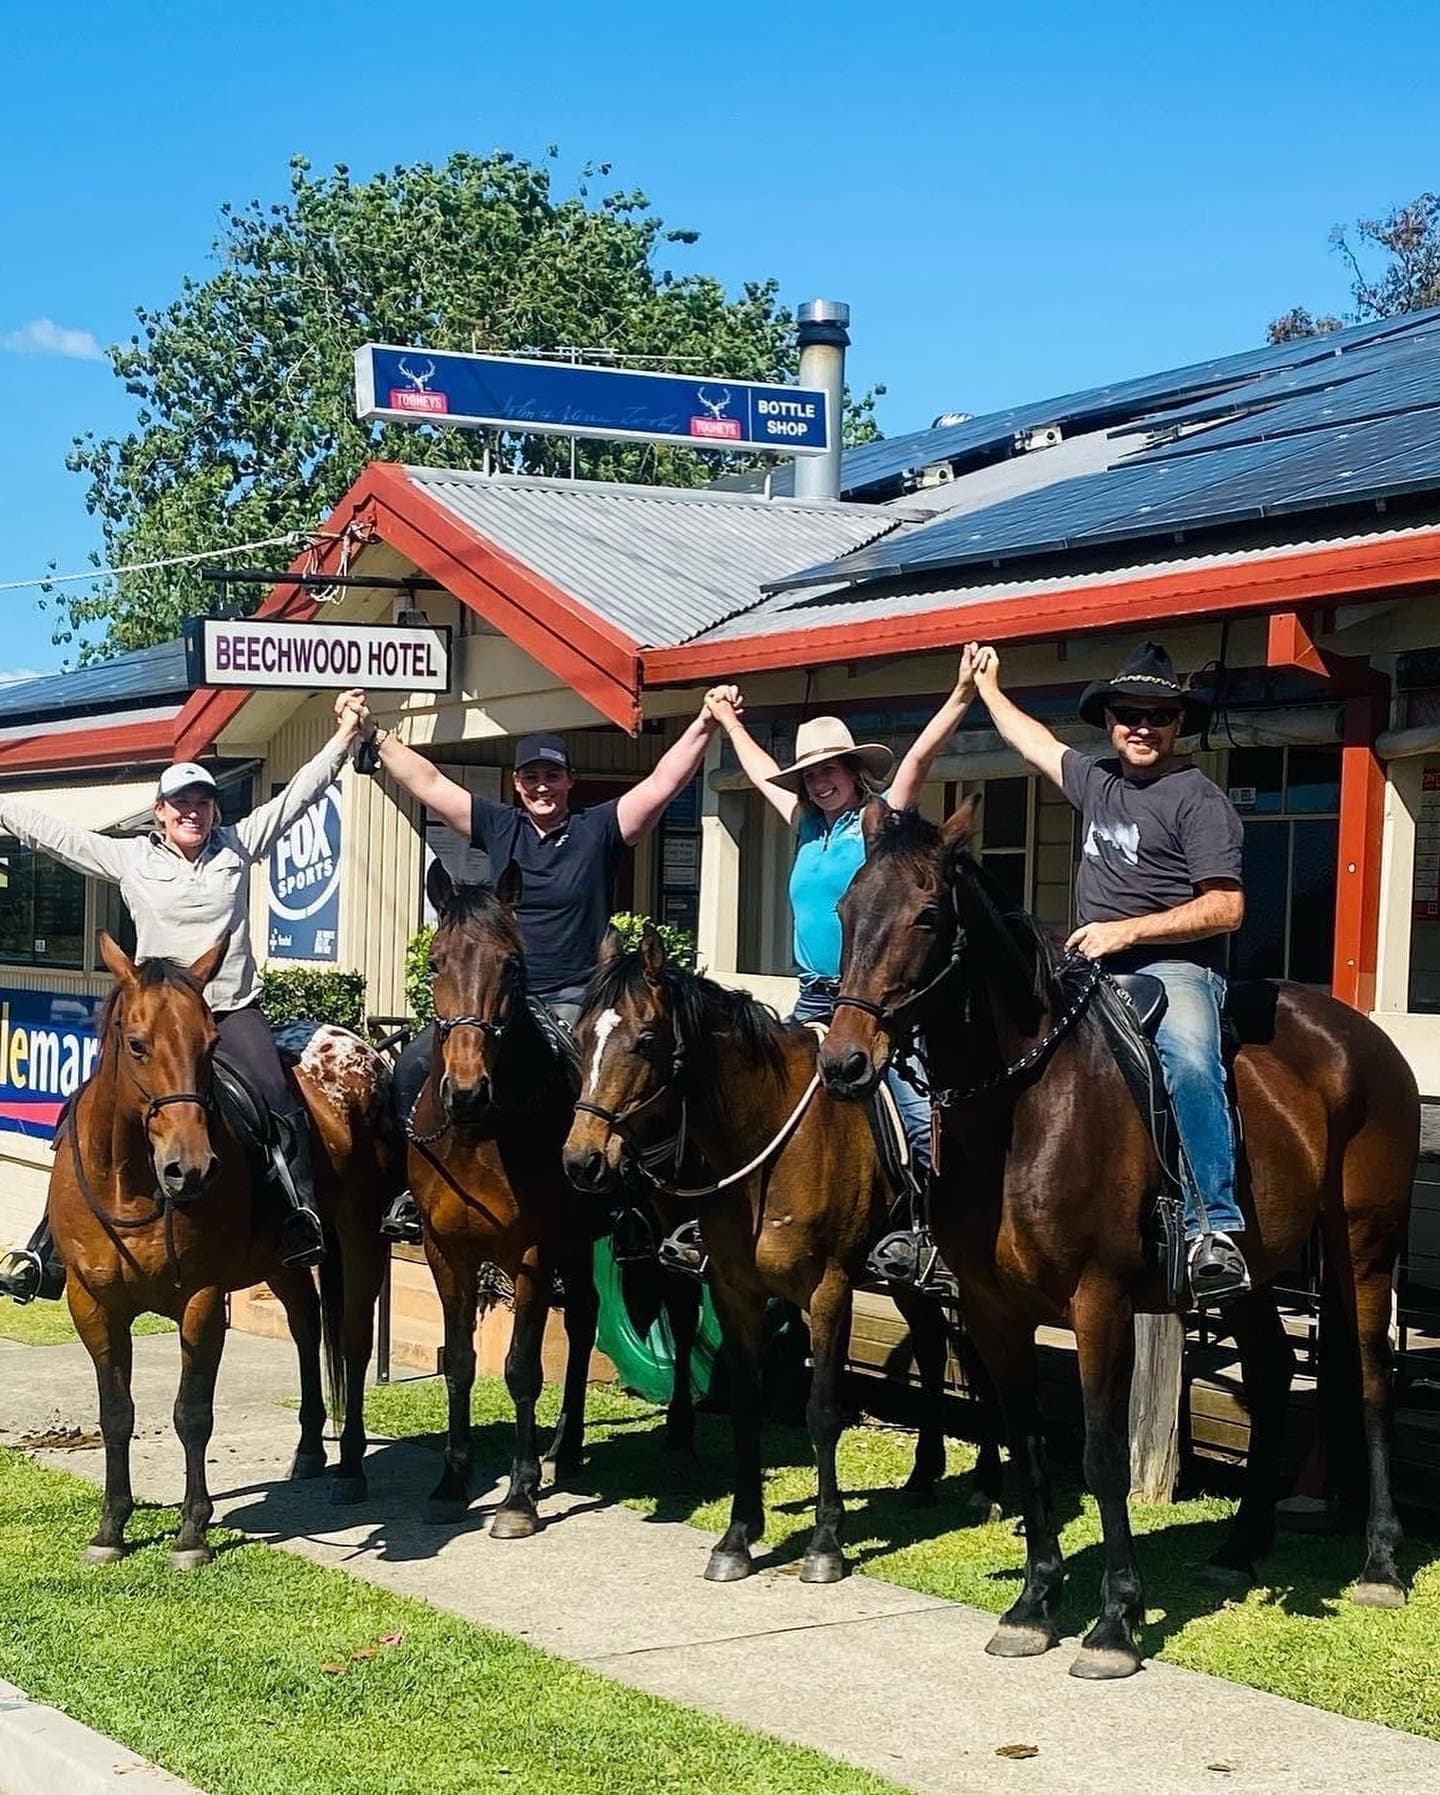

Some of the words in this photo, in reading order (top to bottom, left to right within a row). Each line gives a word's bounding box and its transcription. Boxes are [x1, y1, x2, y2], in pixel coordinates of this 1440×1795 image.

[396, 392, 442, 410] TOOHEYS
[758, 400, 816, 419] BOTTLE
[767, 420, 808, 437] SHOP
[216, 634, 361, 675] BEECHWOOD
[368, 641, 438, 677] HOTEL
[276, 798, 332, 880] FOX
[278, 858, 333, 898] SPORTS
